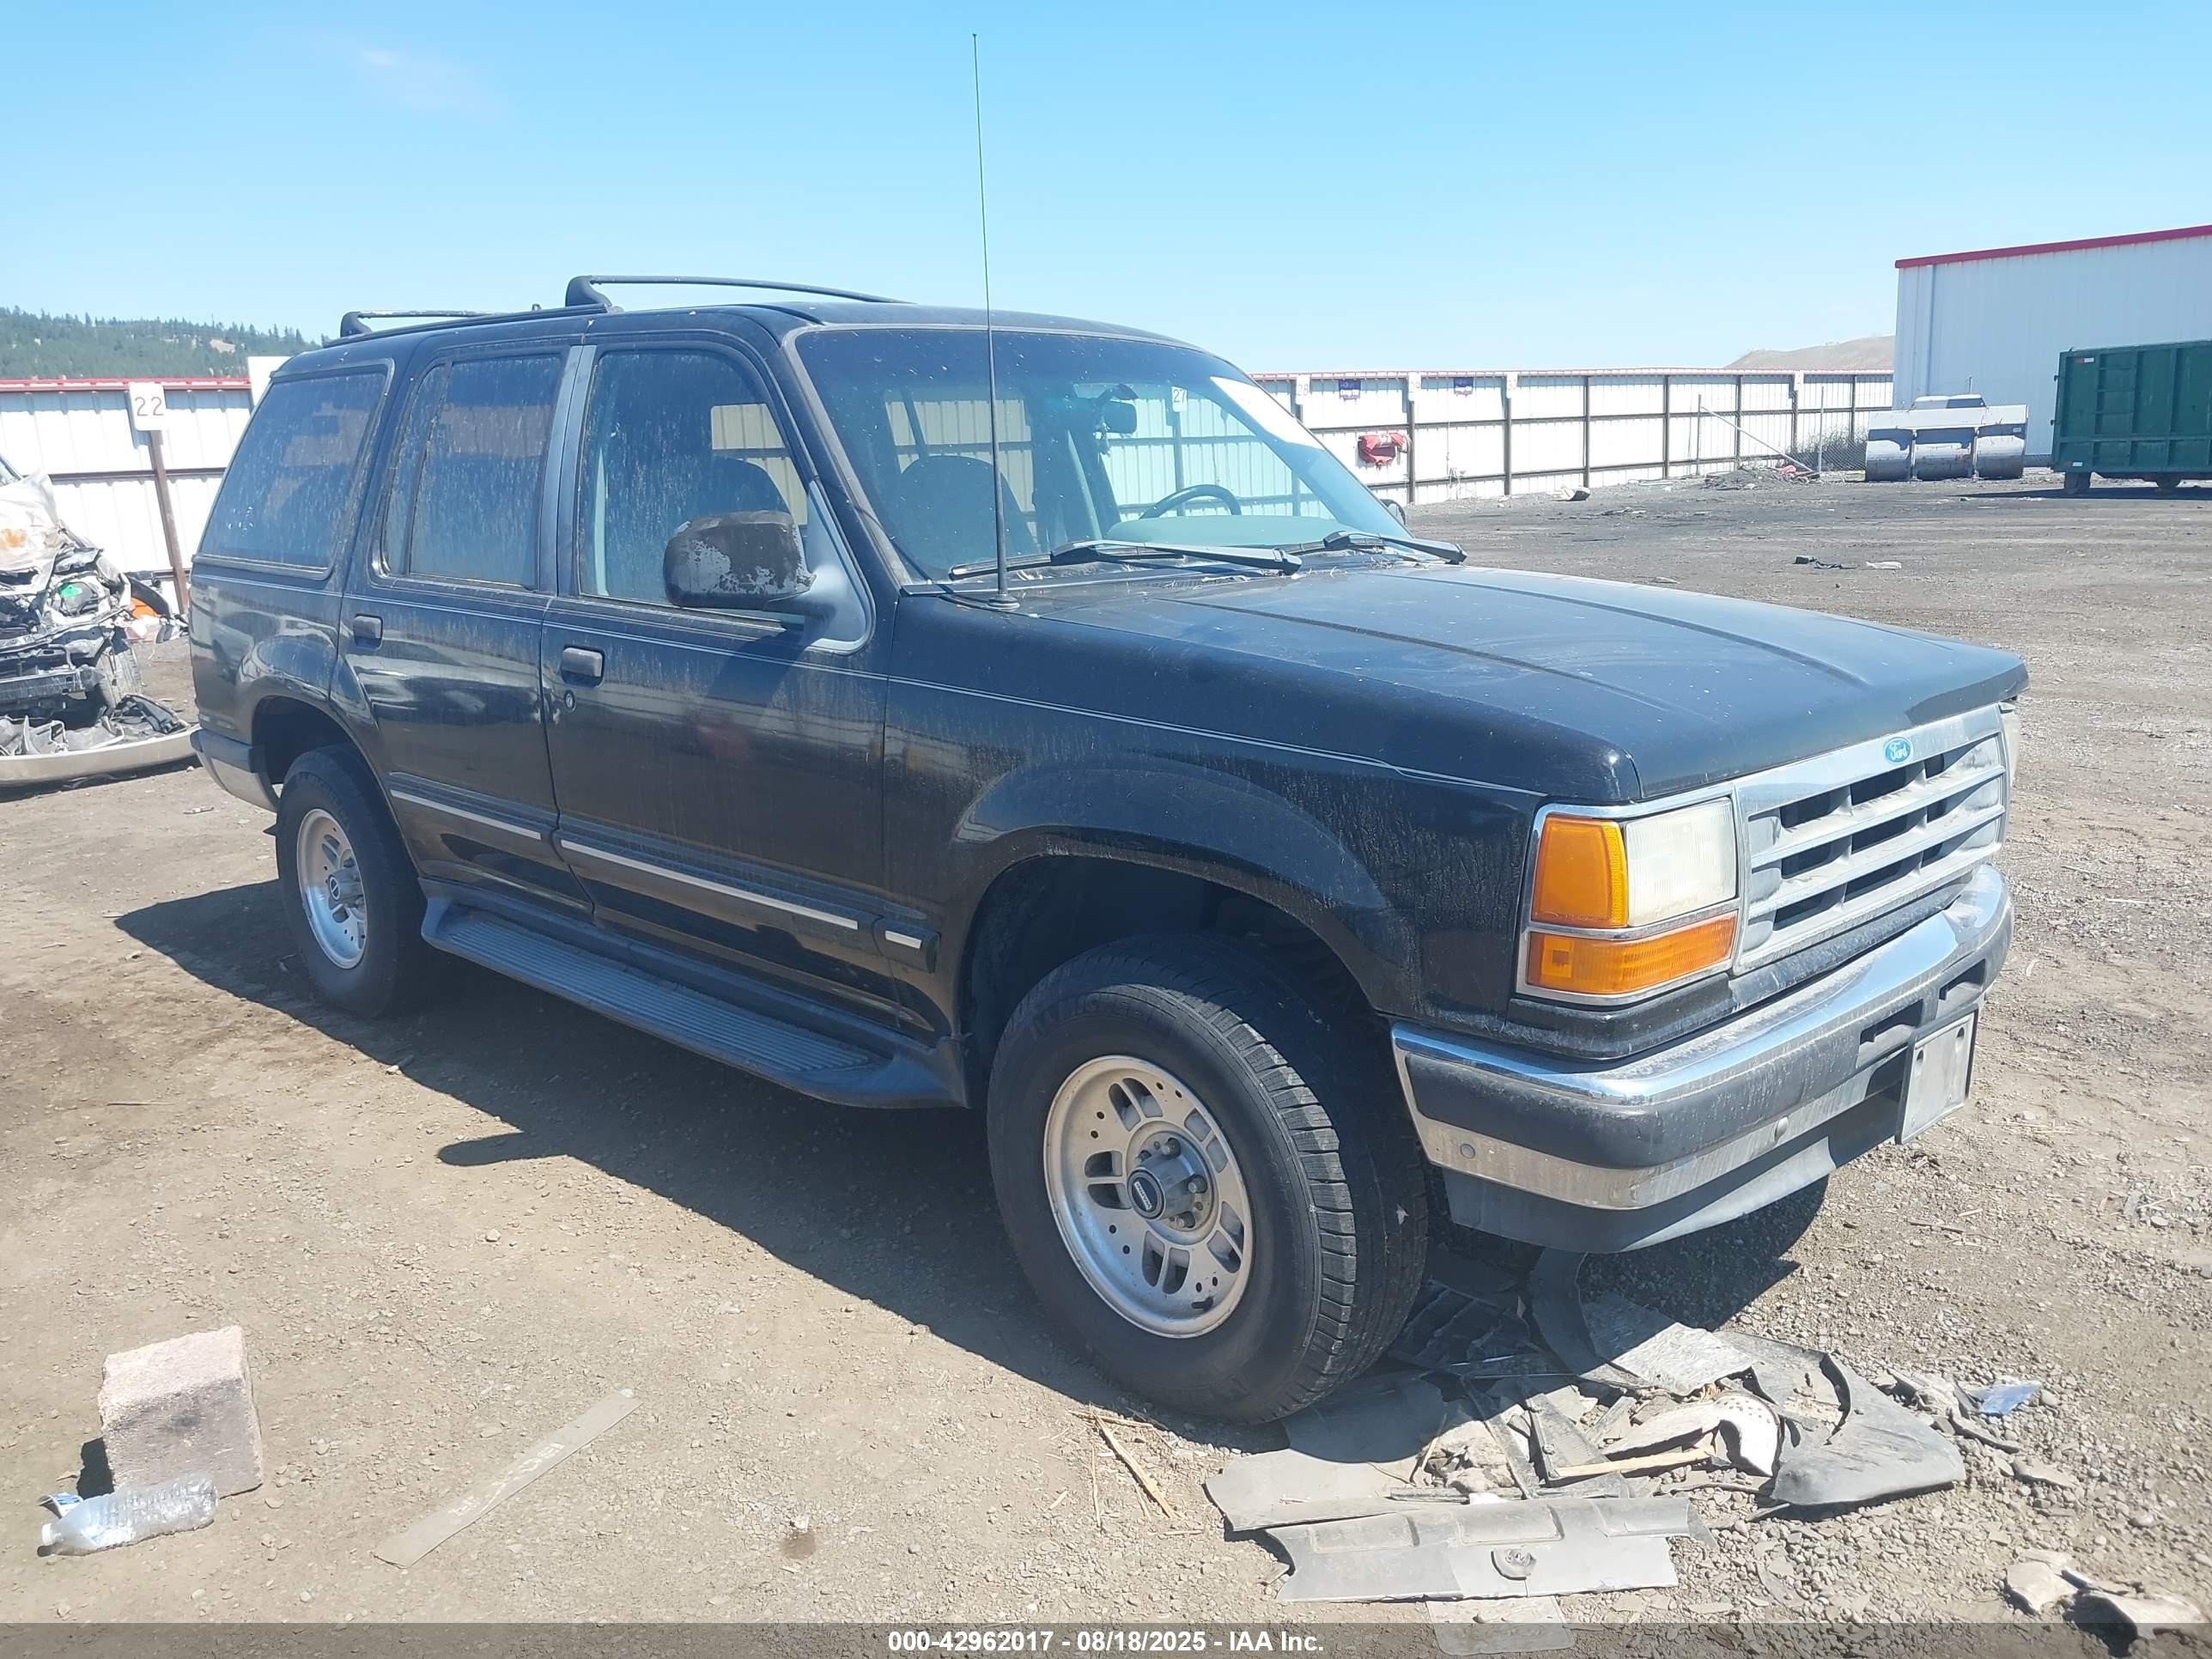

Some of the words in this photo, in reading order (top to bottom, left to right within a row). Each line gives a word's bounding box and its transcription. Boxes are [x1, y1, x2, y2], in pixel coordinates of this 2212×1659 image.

[1173, 388, 1186, 404] 27
[1297, 383, 1309, 396] 28
[134, 396, 164, 416] 22
[1889, 742, 1907, 760] Ford
